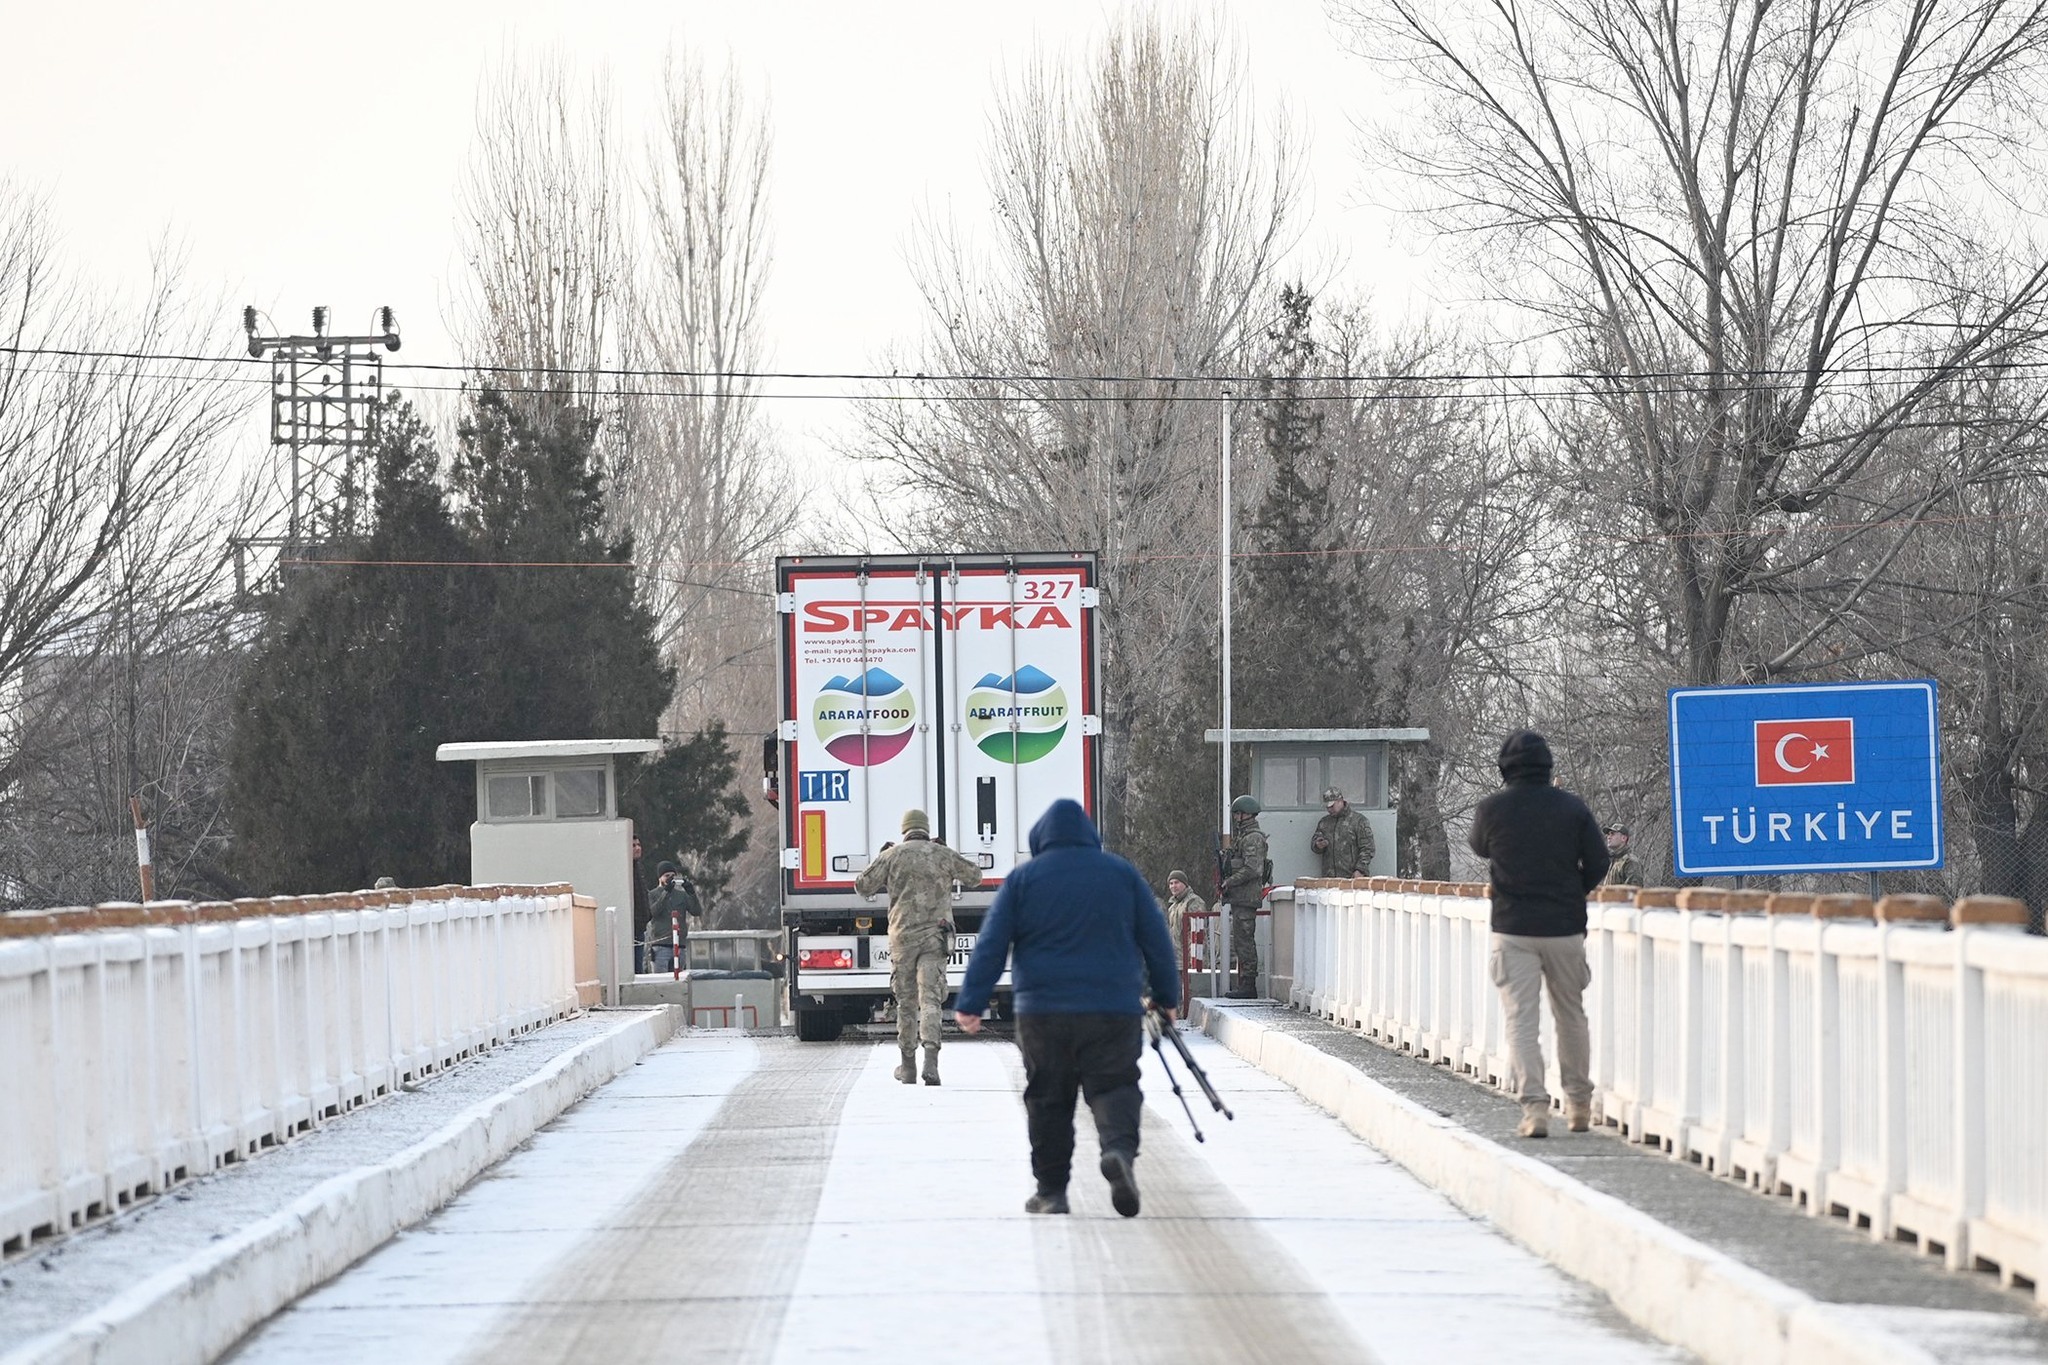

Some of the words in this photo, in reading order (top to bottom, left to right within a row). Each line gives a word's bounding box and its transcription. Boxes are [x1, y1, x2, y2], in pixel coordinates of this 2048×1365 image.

[1024, 581, 1074, 599] 327
[803, 600, 1073, 633] SPAYKA
[834, 647, 916, 656] spaykaspayka.com
[819, 709, 910, 721] ARARATFOOD
[969, 706, 1064, 718] ARARATFRUIT
[803, 773, 845, 800] TIR
[1702, 802, 1913, 845] TÜRKİYE
